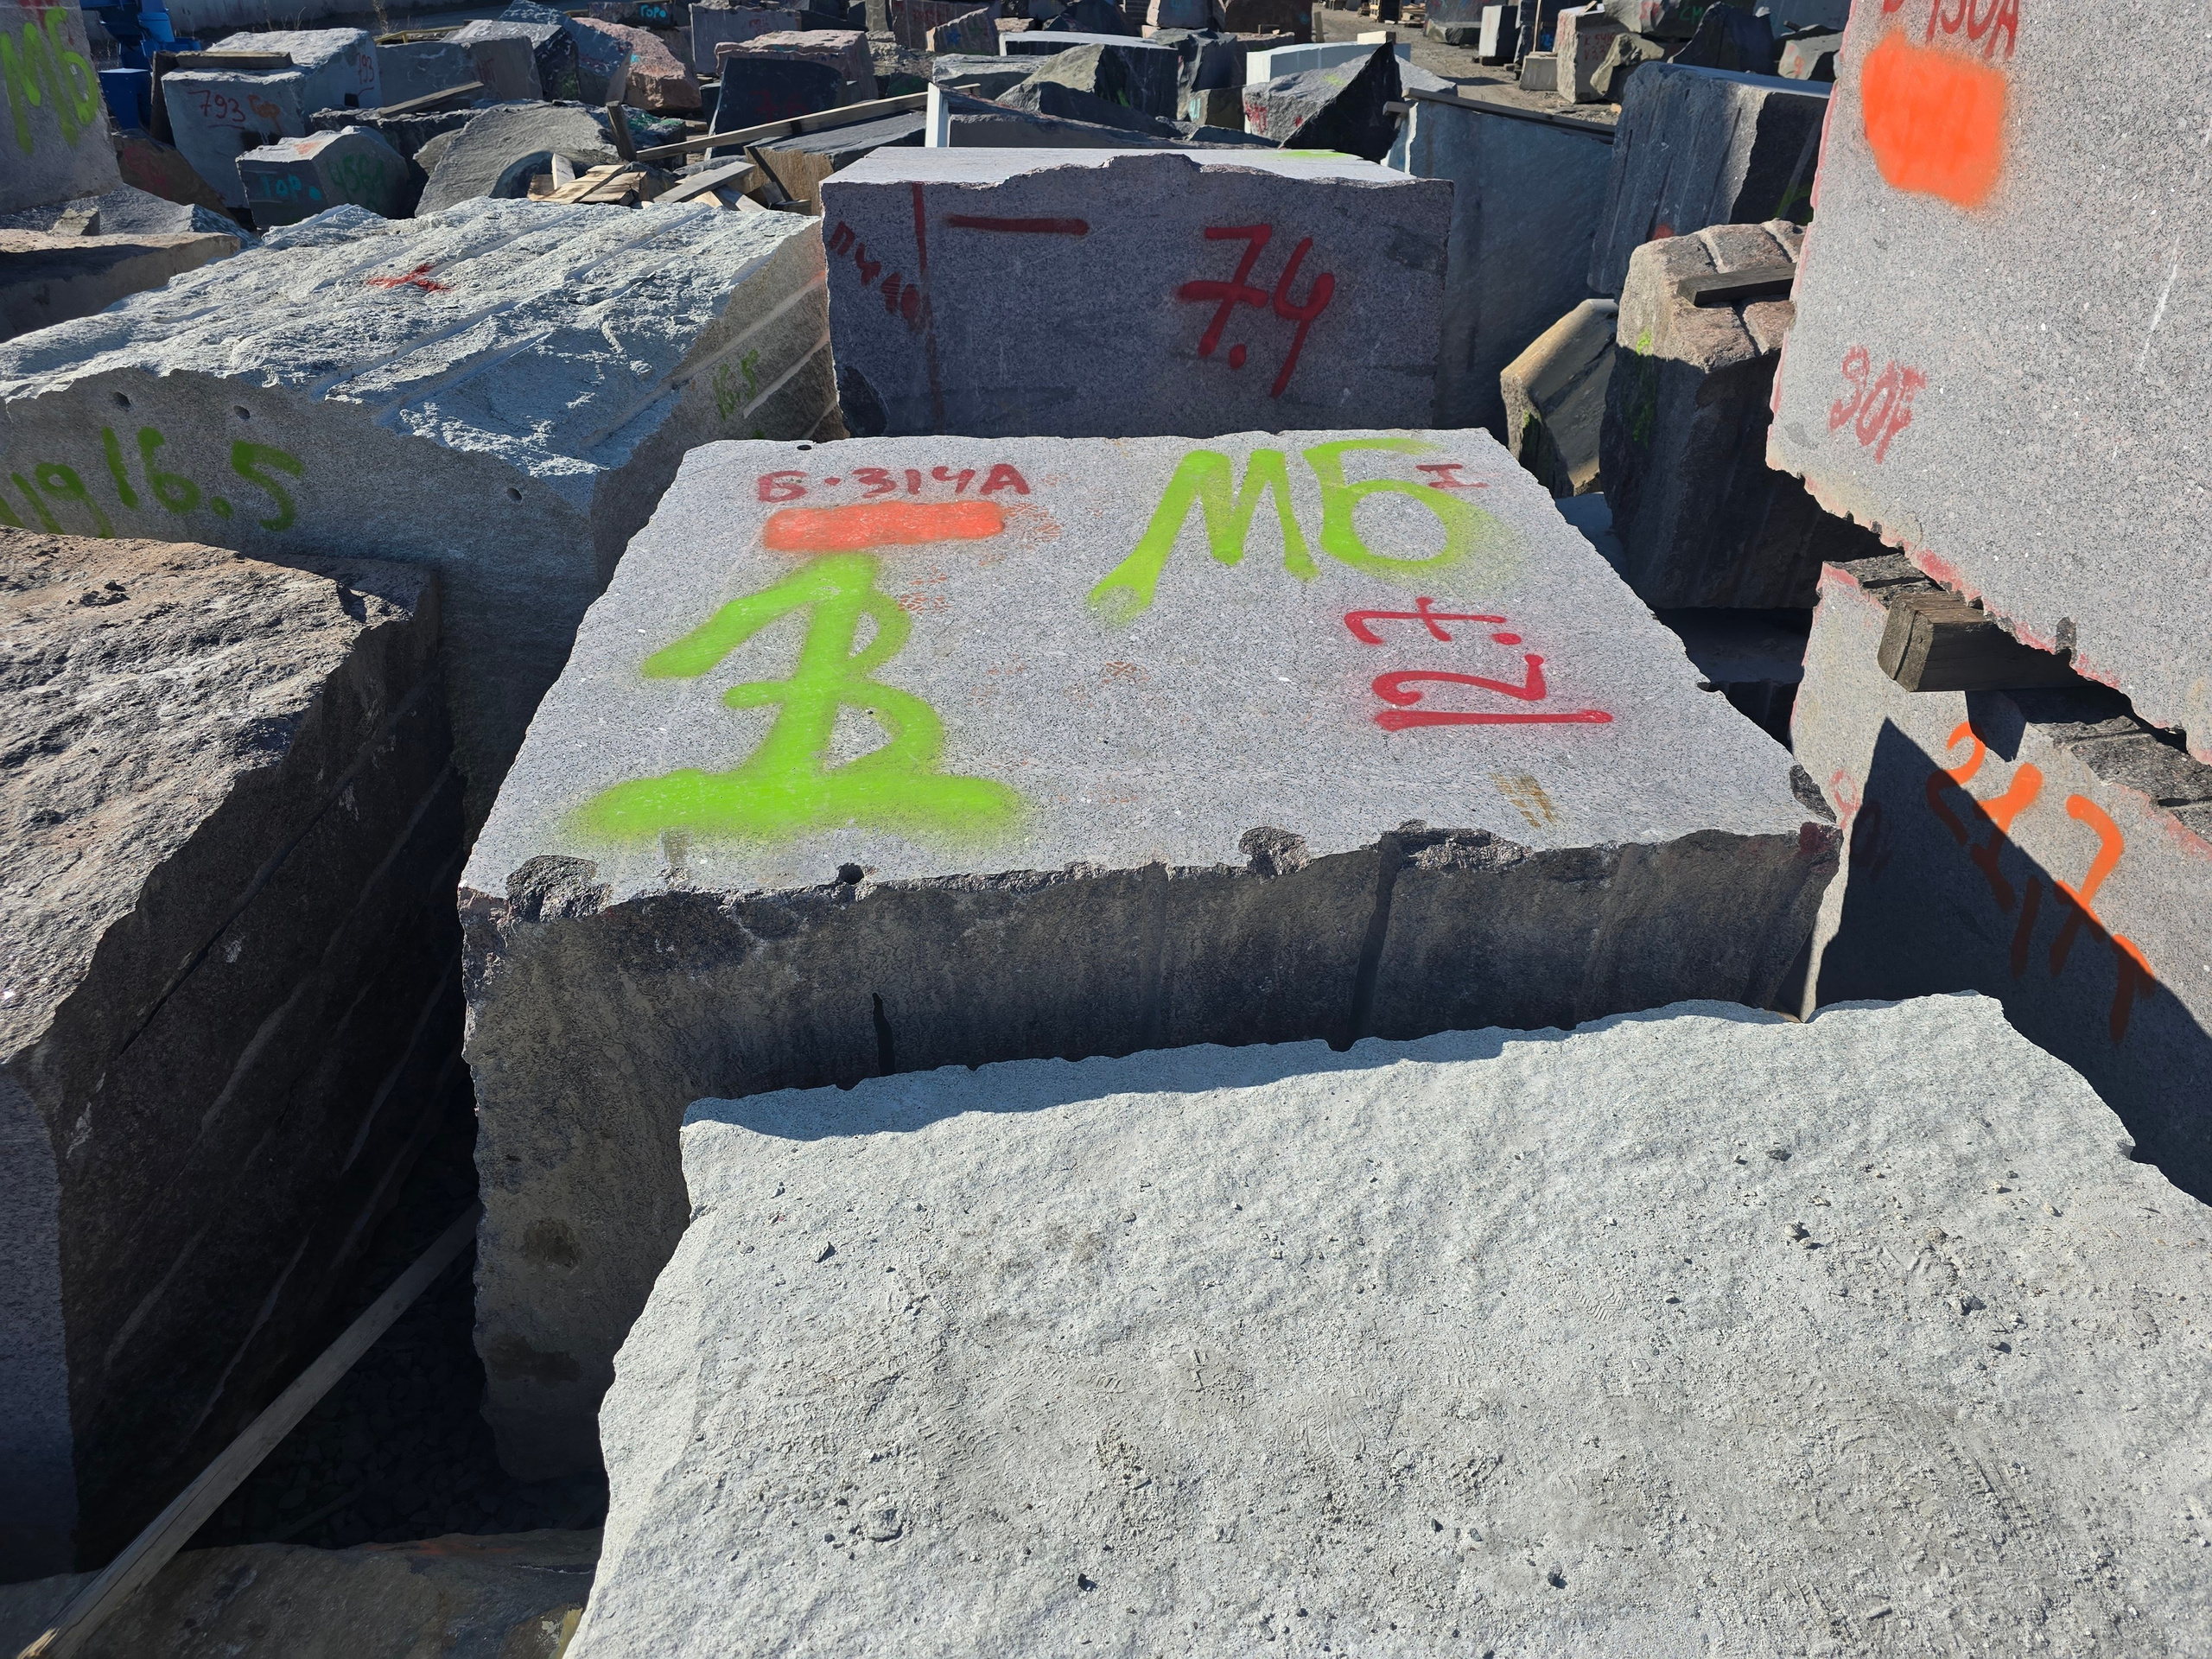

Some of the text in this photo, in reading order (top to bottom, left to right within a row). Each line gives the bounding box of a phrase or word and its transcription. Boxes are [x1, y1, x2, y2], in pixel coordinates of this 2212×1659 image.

[188, 89, 245, 122] 793
[1175, 223, 1336, 398] 7.4
[102, 426, 306, 532] 16.5
